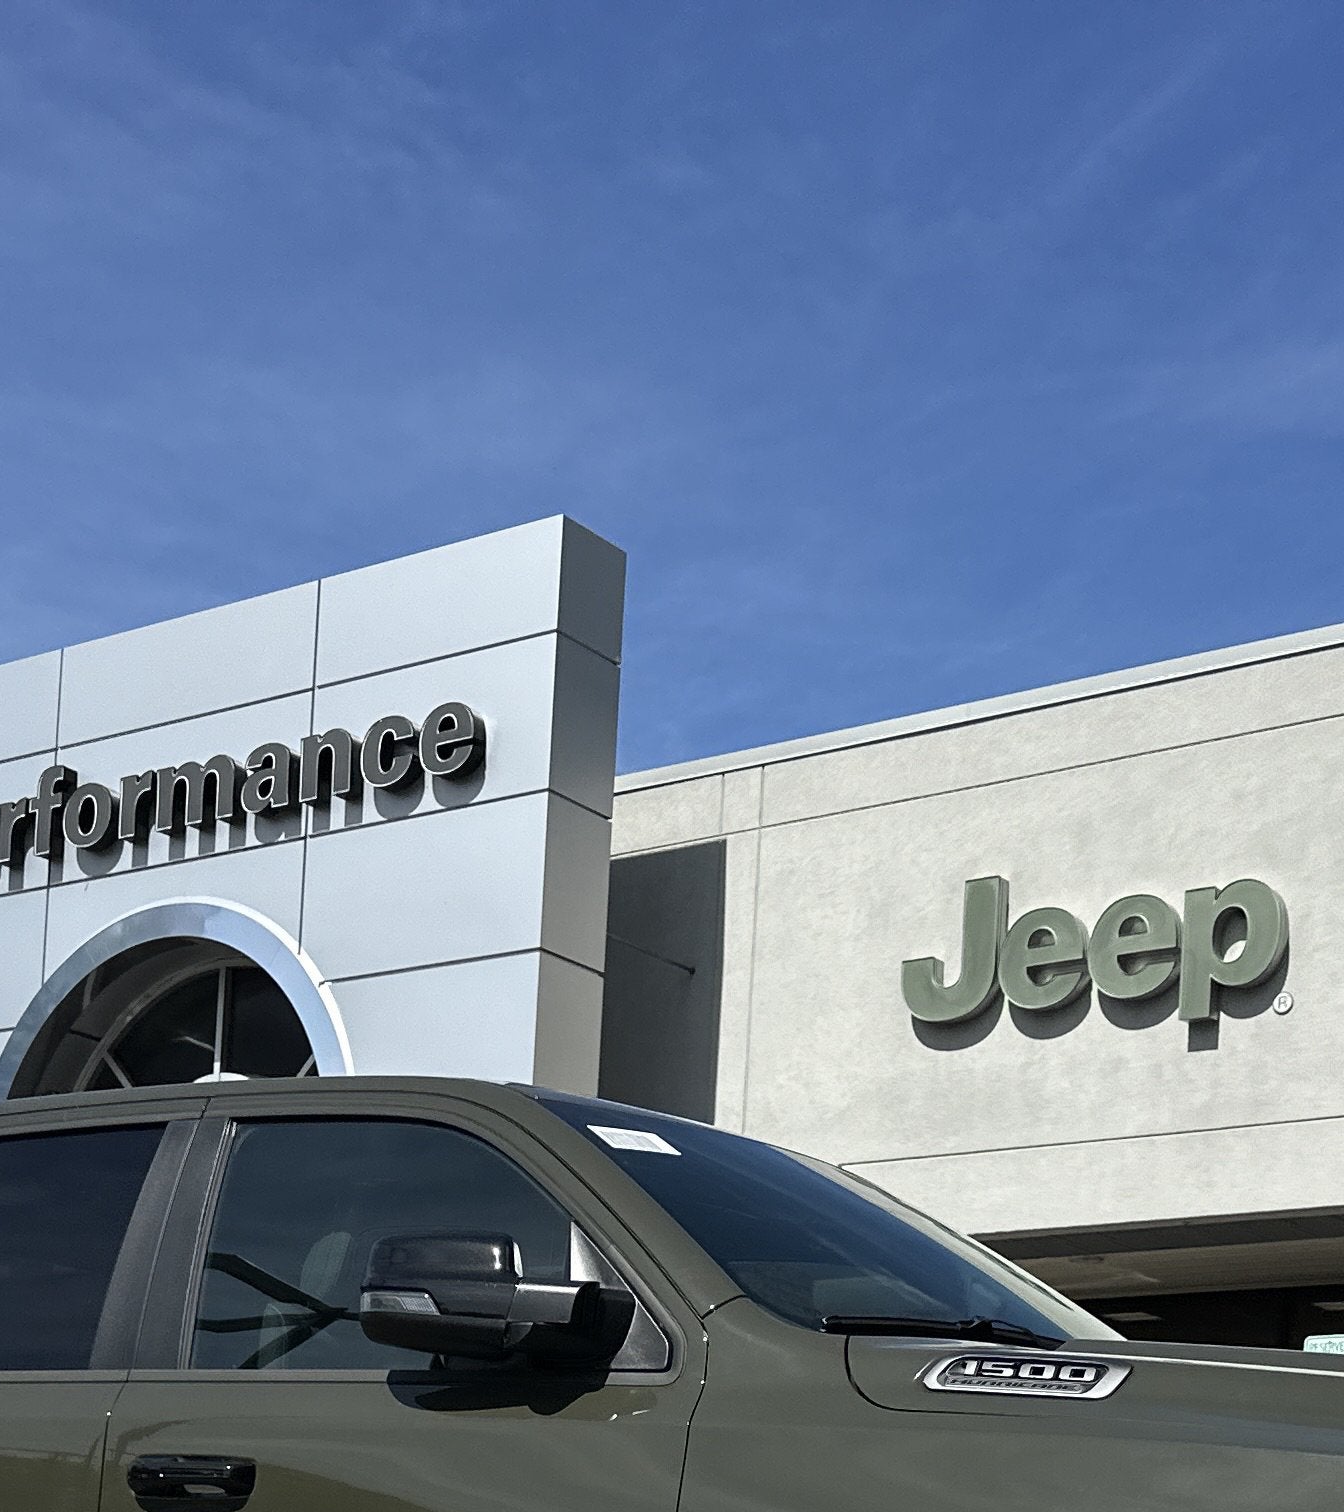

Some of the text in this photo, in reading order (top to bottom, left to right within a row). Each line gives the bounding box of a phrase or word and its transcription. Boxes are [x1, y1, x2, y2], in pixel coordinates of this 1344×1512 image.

[901, 875, 1290, 1022] Jeep
[960, 1360, 1099, 1381] 1500
[949, 1378, 1080, 1392] HURRICANE
